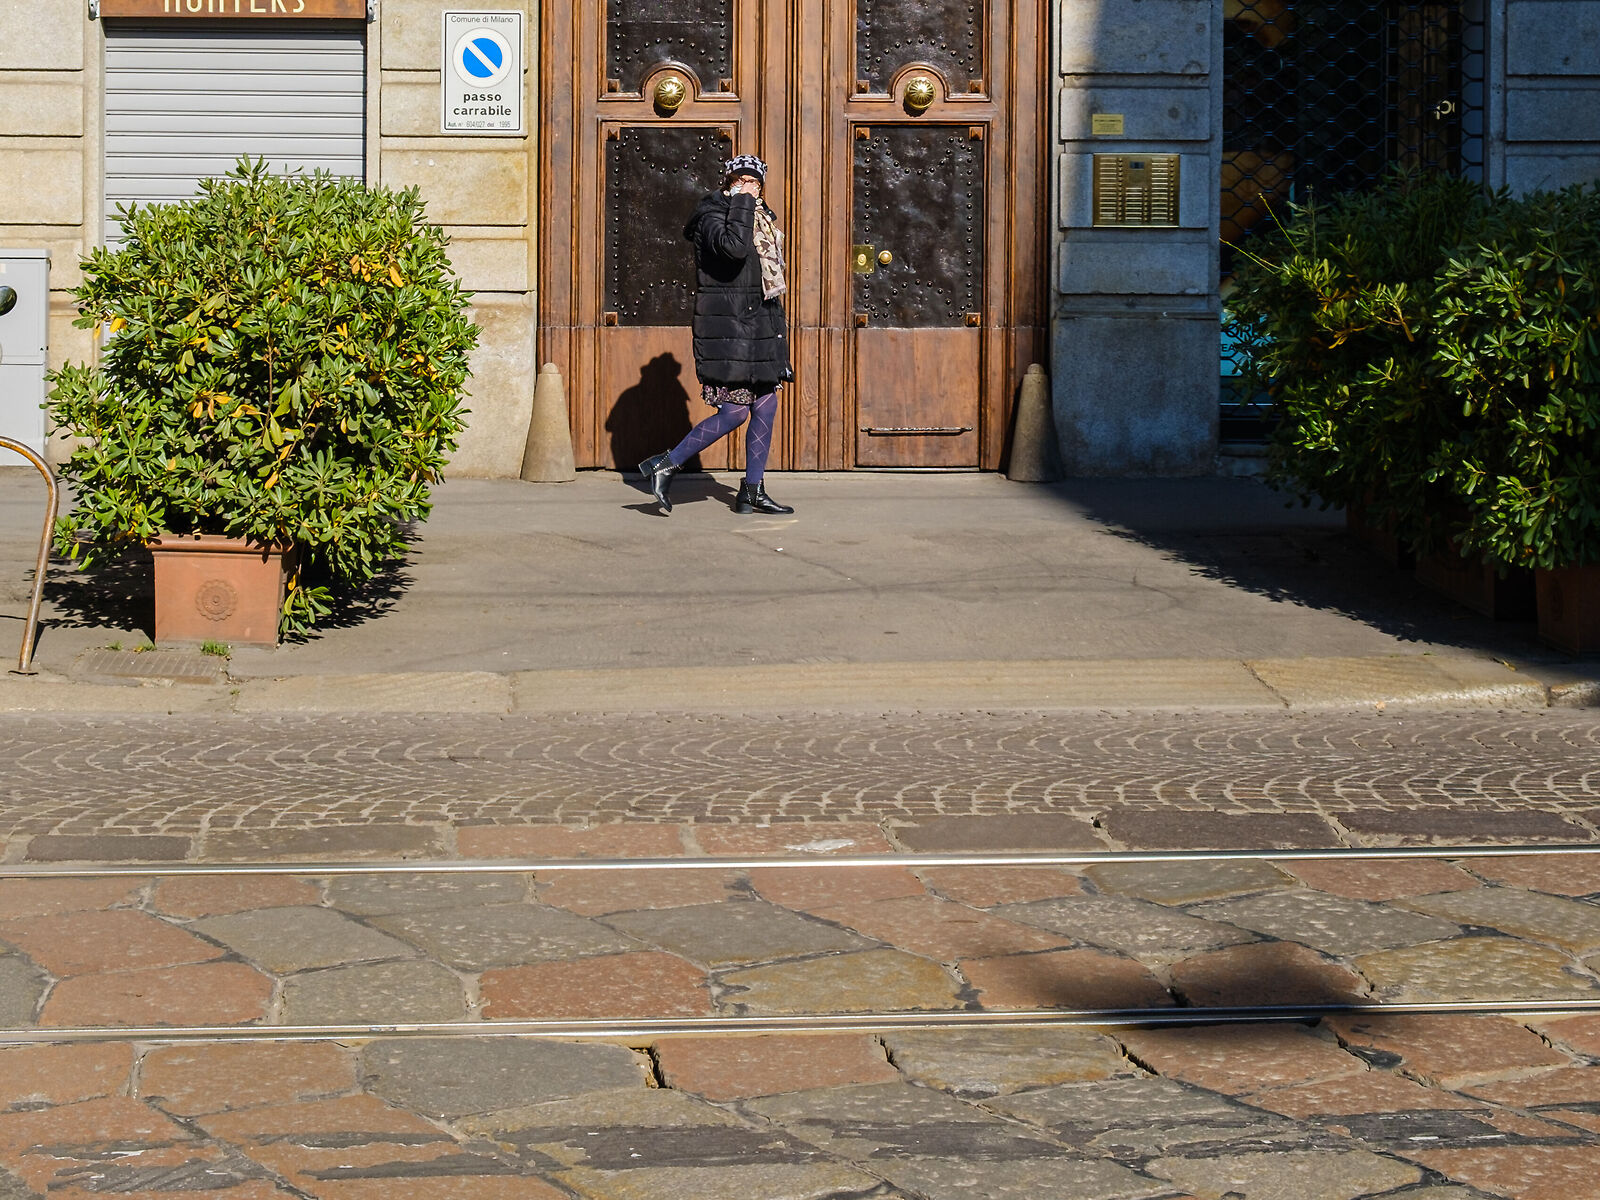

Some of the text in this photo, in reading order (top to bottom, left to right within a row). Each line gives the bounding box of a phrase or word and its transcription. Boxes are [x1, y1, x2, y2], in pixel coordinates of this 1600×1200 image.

[451, 15, 514, 23] Comune di Milano
[463, 93, 502, 103] passo
[453, 105, 512, 116] carrabile
